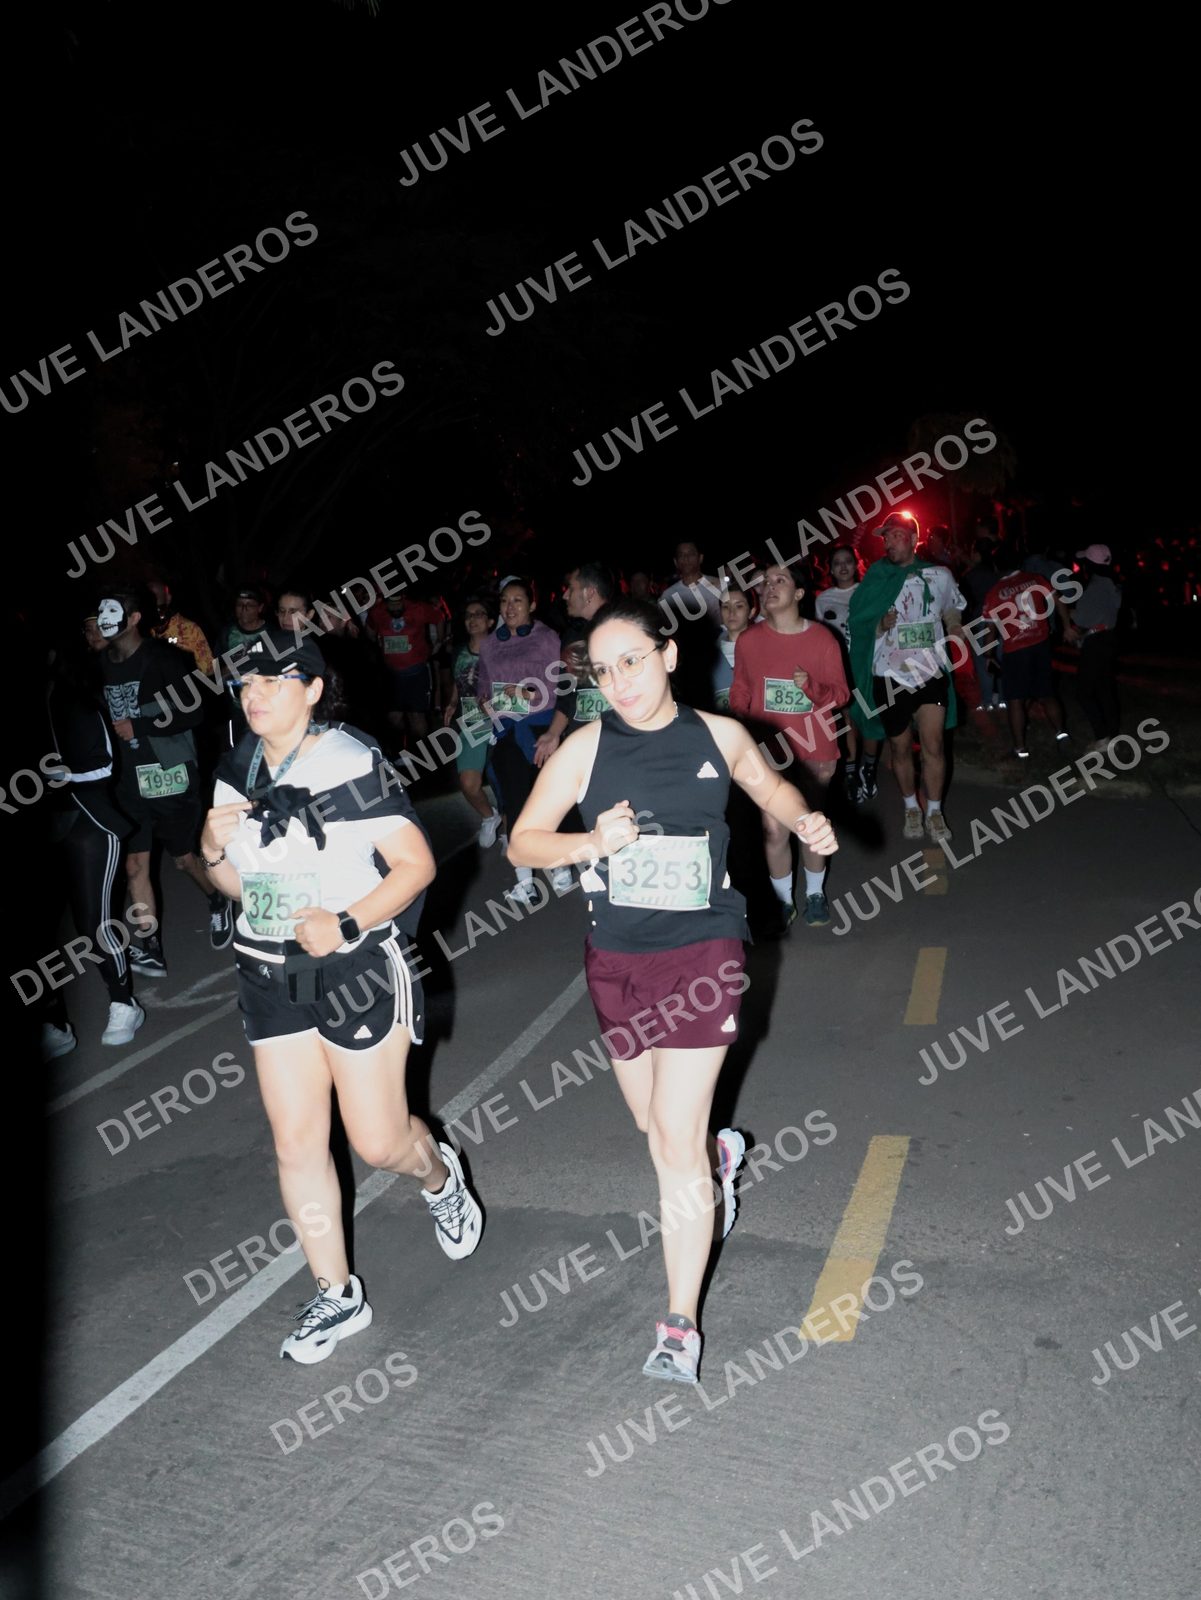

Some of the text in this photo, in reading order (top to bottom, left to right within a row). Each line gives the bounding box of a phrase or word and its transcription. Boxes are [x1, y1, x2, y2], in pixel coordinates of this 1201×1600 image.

[902, 630, 933, 643] 1342
[580, 698, 609, 713] 120
[775, 689, 805, 706] 852
[144, 770, 183, 789] 1996
[620, 858, 702, 892] 3253
